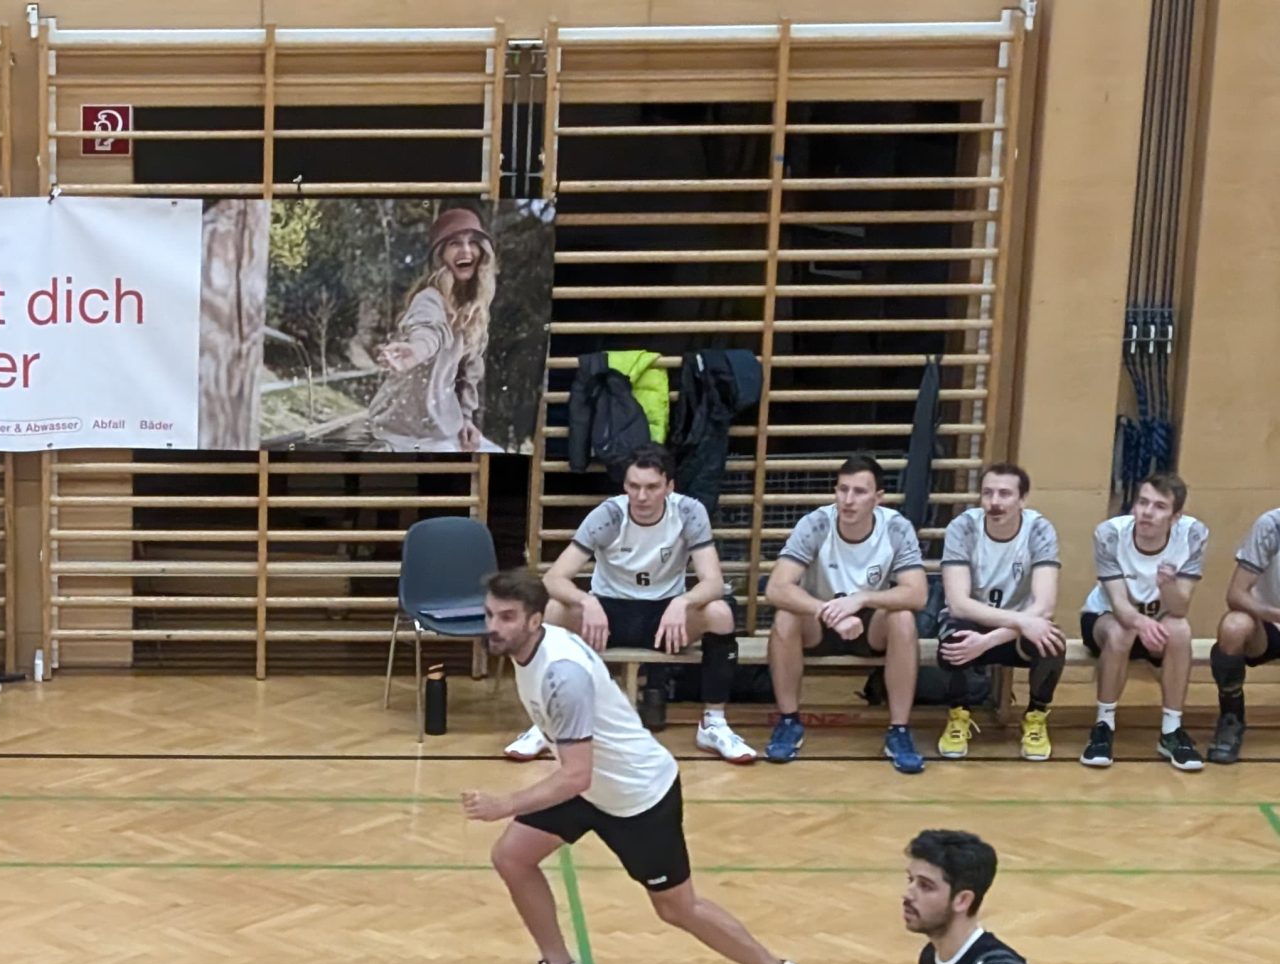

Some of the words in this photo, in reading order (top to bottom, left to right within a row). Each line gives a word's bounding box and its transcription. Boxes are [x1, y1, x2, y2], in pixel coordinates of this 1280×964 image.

[27, 276, 144, 325] dich
[25, 420, 79, 433] Abwasser
[92, 419, 125, 430] Abfall
[139, 419, 174, 431] Bäder
[635, 571, 651, 587] 6
